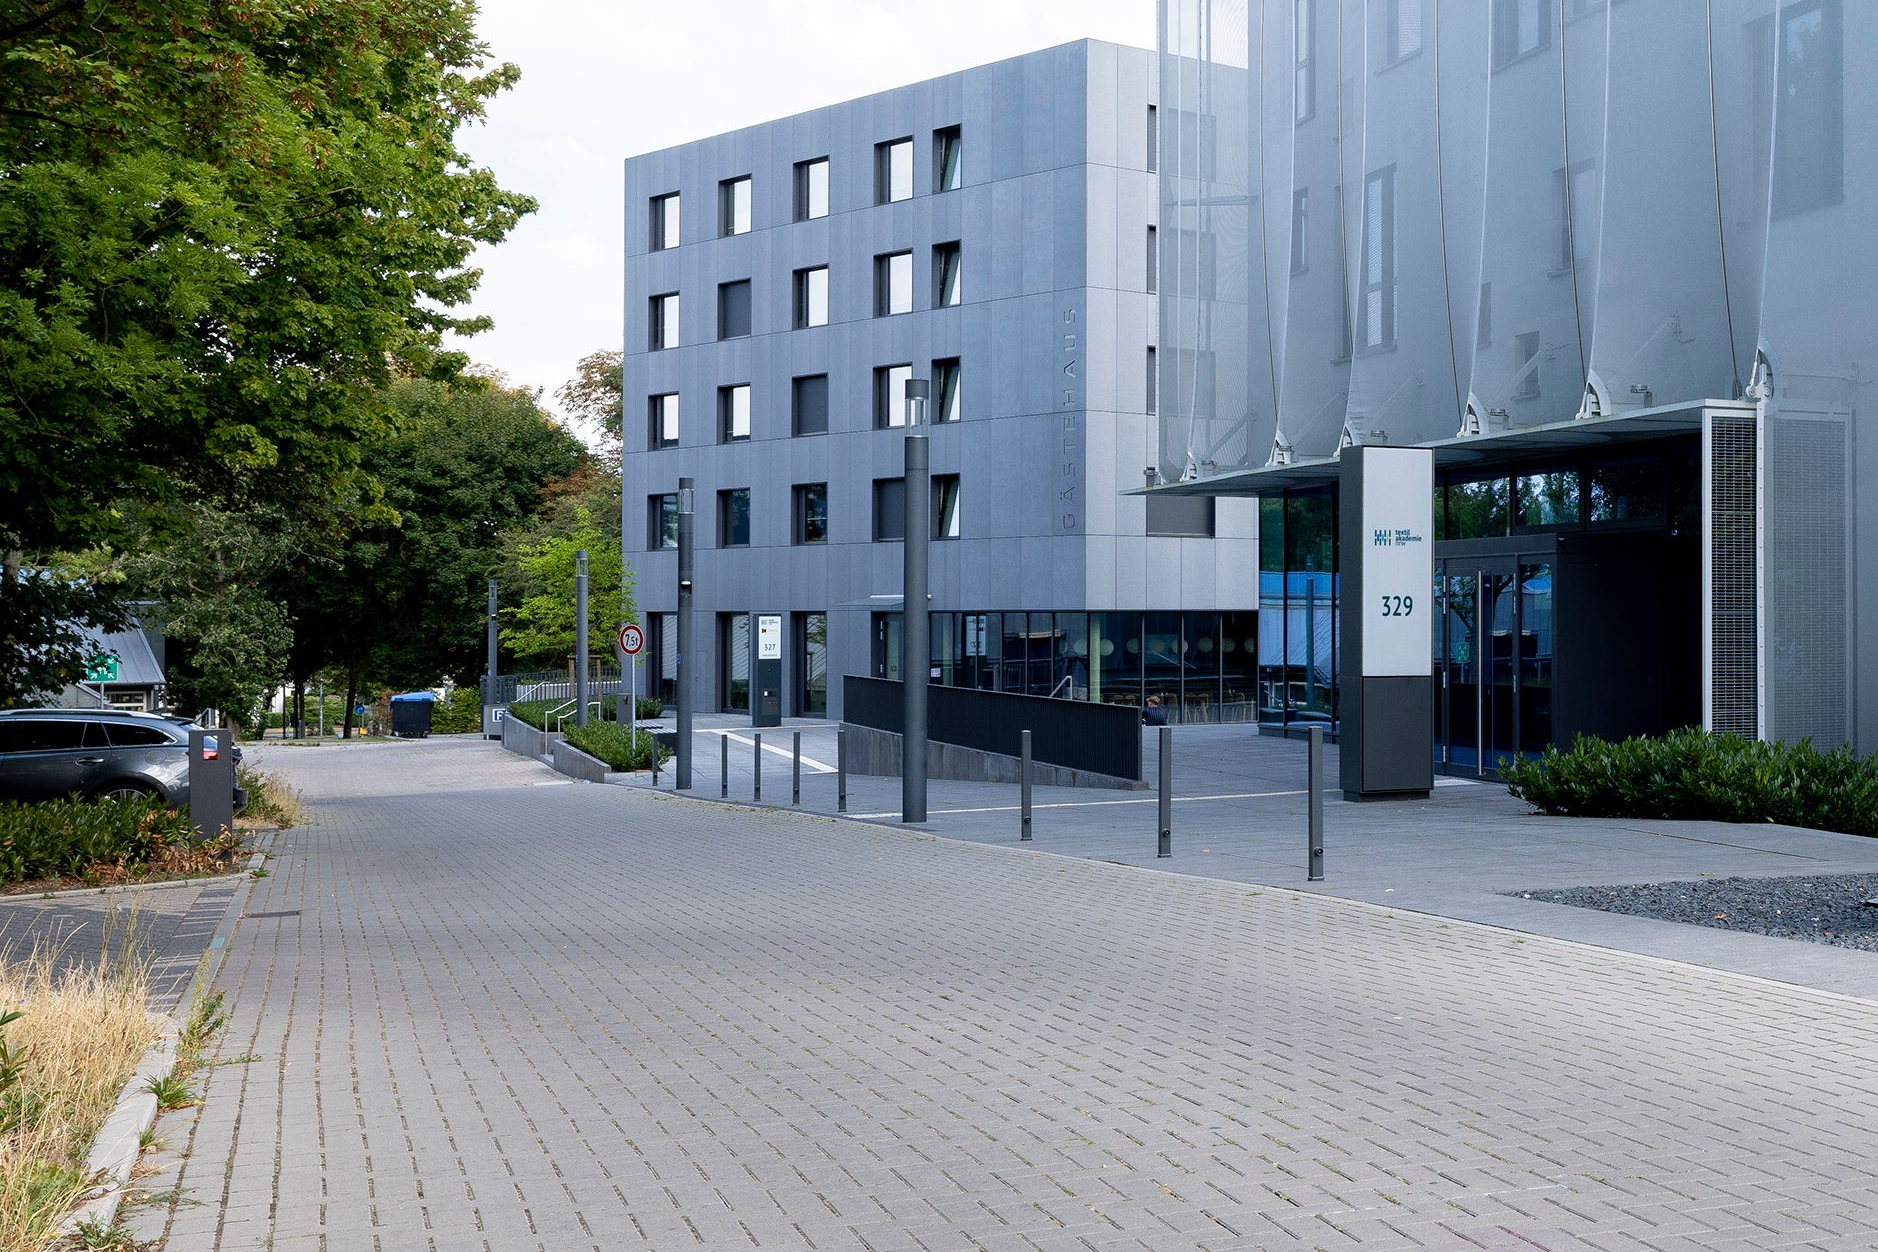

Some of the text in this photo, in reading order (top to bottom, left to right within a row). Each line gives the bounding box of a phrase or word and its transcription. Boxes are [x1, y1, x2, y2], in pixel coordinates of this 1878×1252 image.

[1060, 308, 1077, 530] GÄSTEHAUS
[1382, 595, 1413, 617] 329
[764, 643, 776, 651] 327
